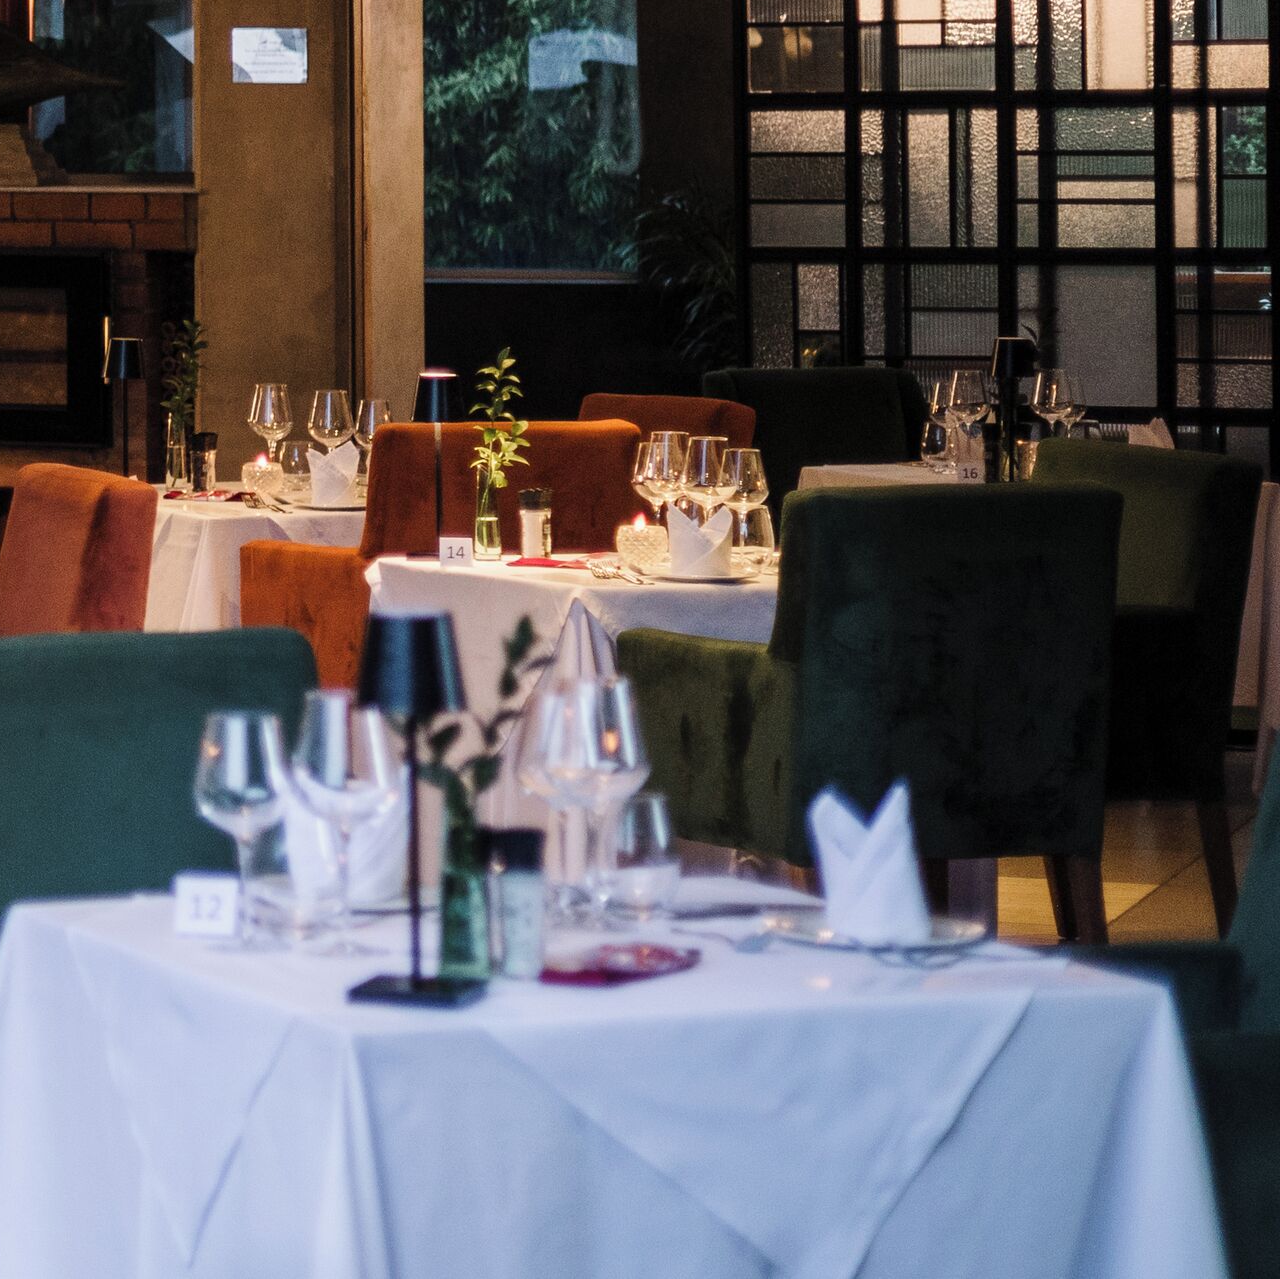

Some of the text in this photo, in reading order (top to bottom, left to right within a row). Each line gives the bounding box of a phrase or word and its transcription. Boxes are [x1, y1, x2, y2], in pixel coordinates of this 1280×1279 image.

[962, 467, 978, 479] 16
[447, 546, 466, 559] 14
[190, 894, 222, 920] 12
